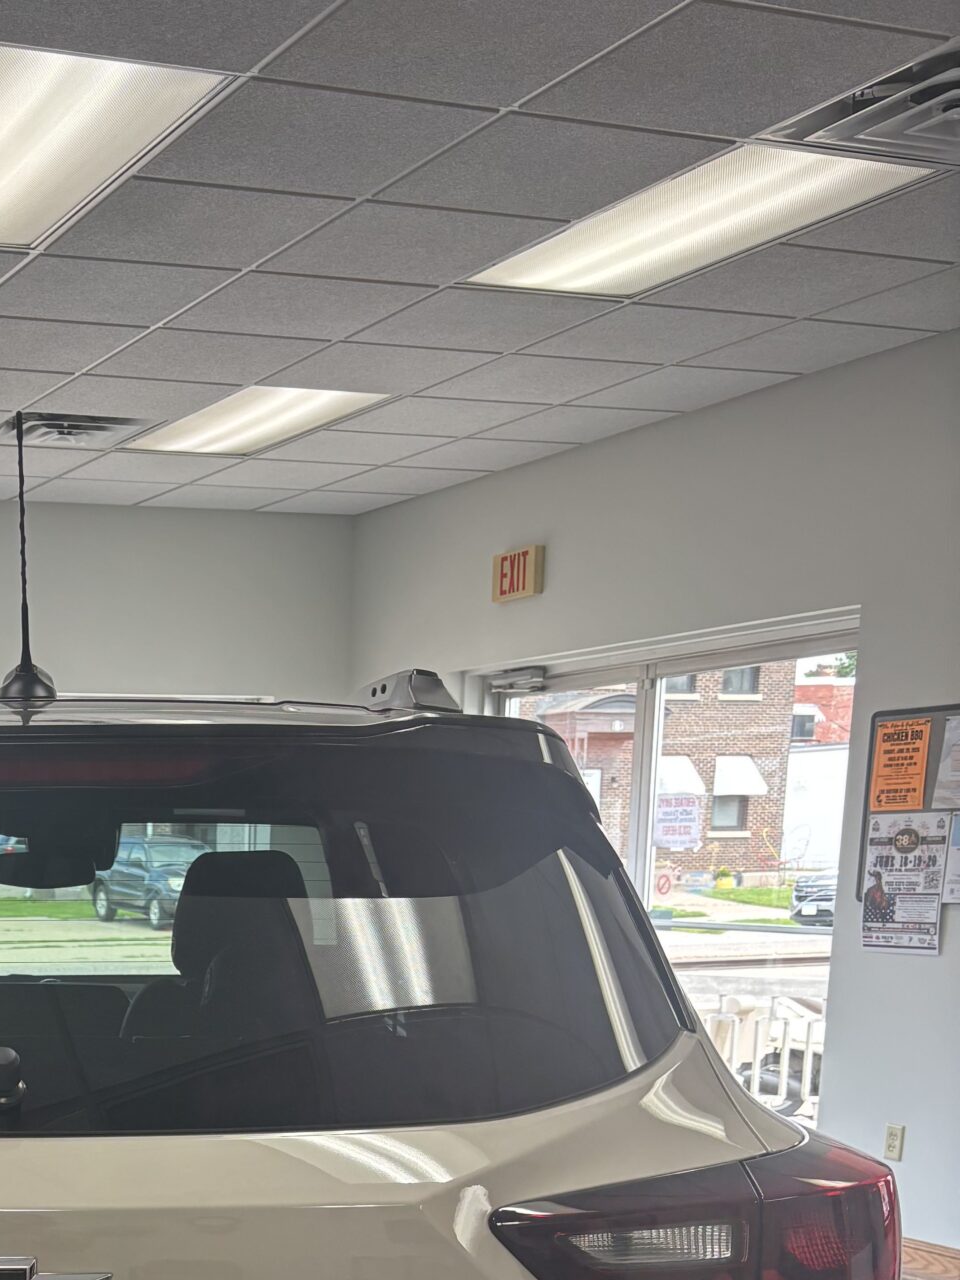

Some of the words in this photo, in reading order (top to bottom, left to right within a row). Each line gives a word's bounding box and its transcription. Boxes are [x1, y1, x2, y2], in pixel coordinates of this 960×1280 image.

[500, 550, 529, 596] EXIT
[882, 731, 909, 743] CHICKEN
[911, 729, 923, 741] BBQ
[895, 834, 910, 846] 38
[873, 855, 895, 868] JUNE
